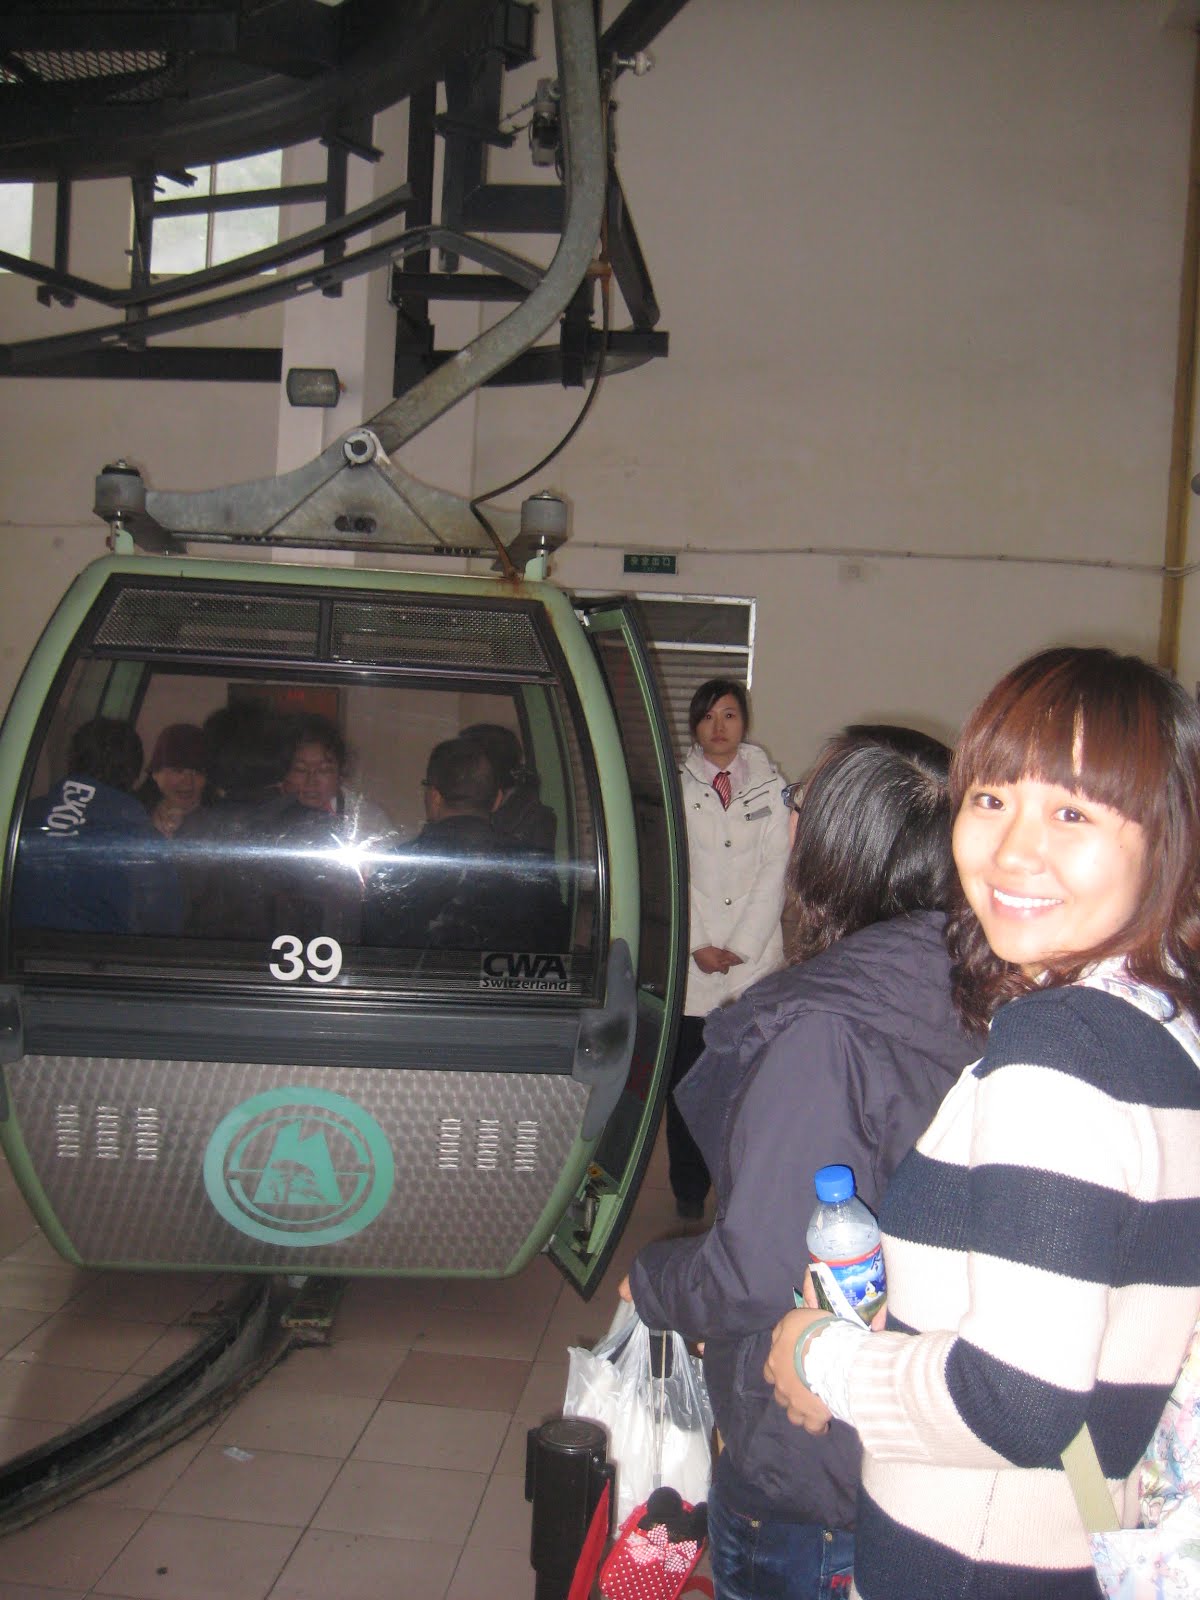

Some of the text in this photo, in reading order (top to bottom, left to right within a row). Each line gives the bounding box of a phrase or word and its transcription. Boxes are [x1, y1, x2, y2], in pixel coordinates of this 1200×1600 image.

[269, 934, 343, 983] 39
[483, 952, 568, 980] CWA
[482, 976, 568, 991] Switzerland
